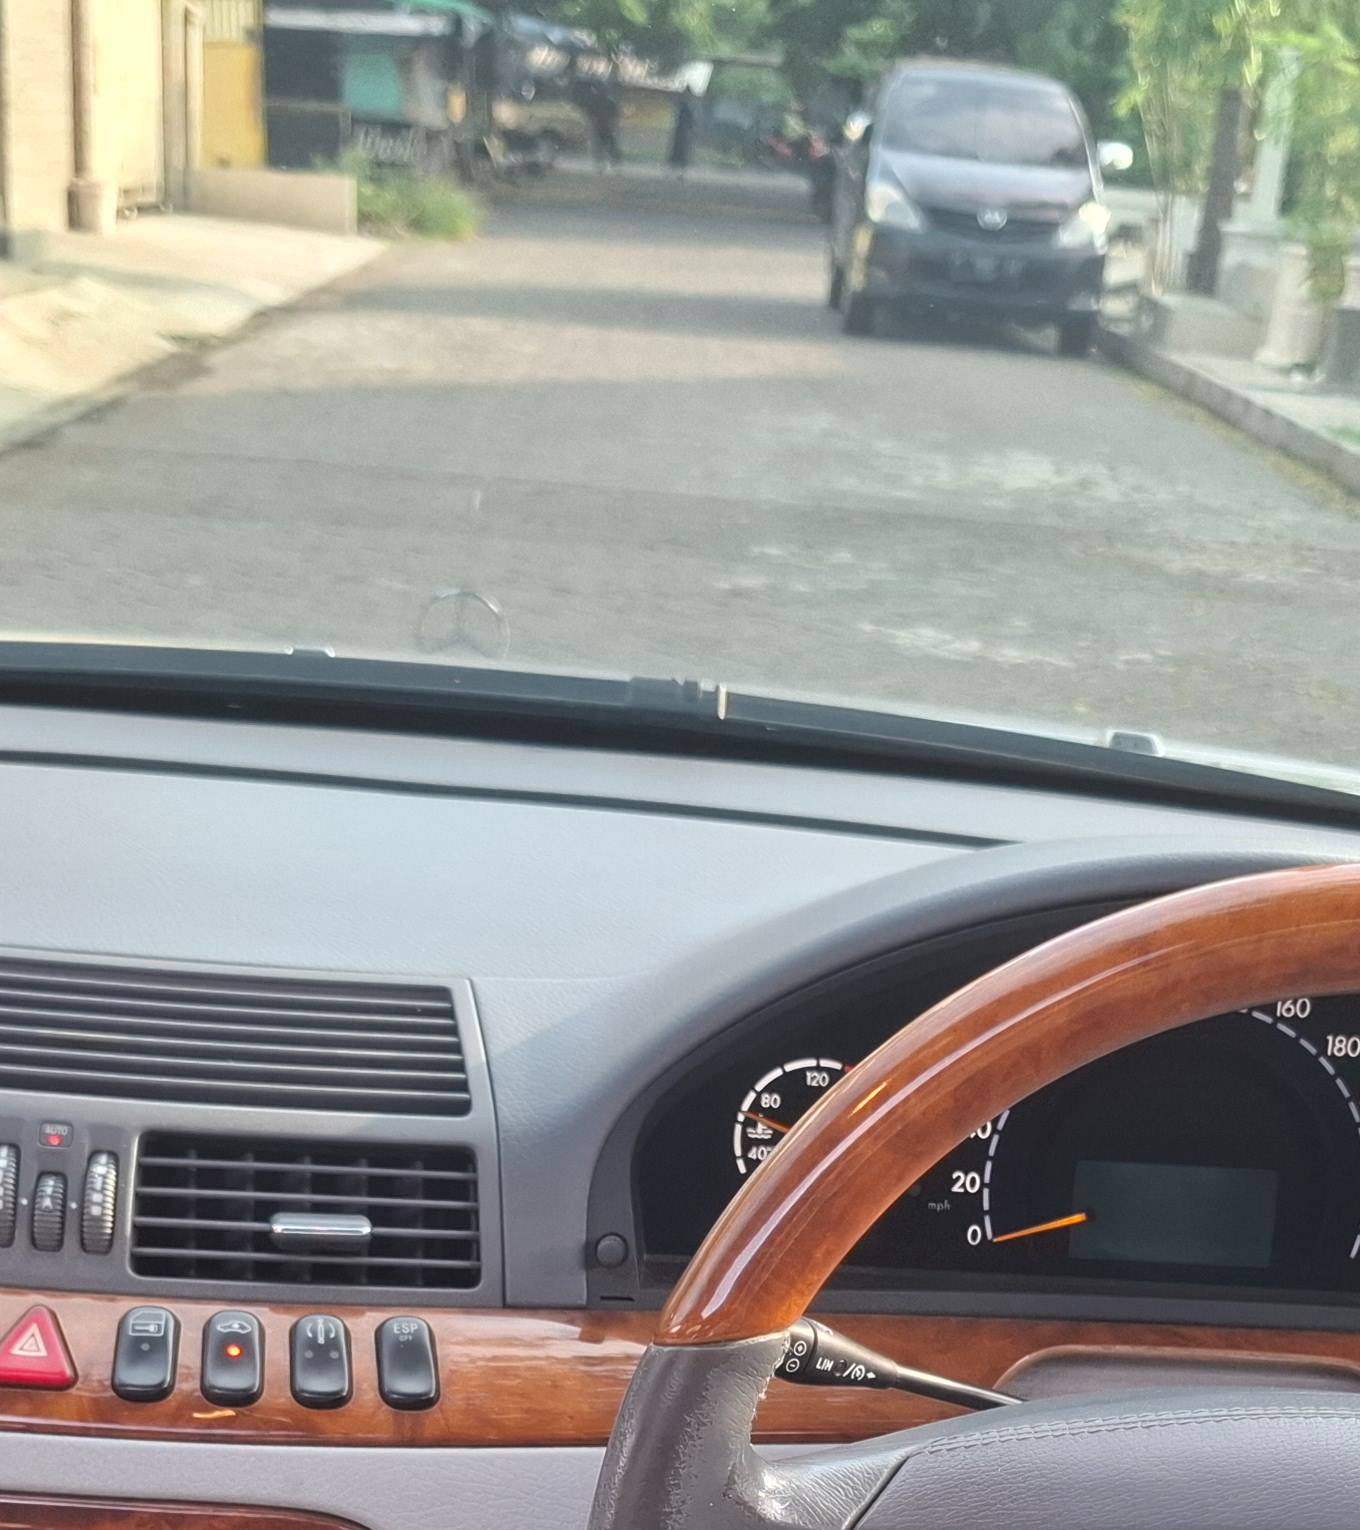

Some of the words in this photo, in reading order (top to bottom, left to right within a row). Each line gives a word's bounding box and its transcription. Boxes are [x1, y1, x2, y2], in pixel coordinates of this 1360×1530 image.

[1276, 998, 1311, 1018] 160
[806, 1071, 829, 1088] 120
[760, 1093, 781, 1110] 80
[951, 1172, 981, 1194] 20
[928, 1201, 951, 1212] mph
[967, 1224, 982, 1245] 0
[393, 1322, 418, 1334] ESP
